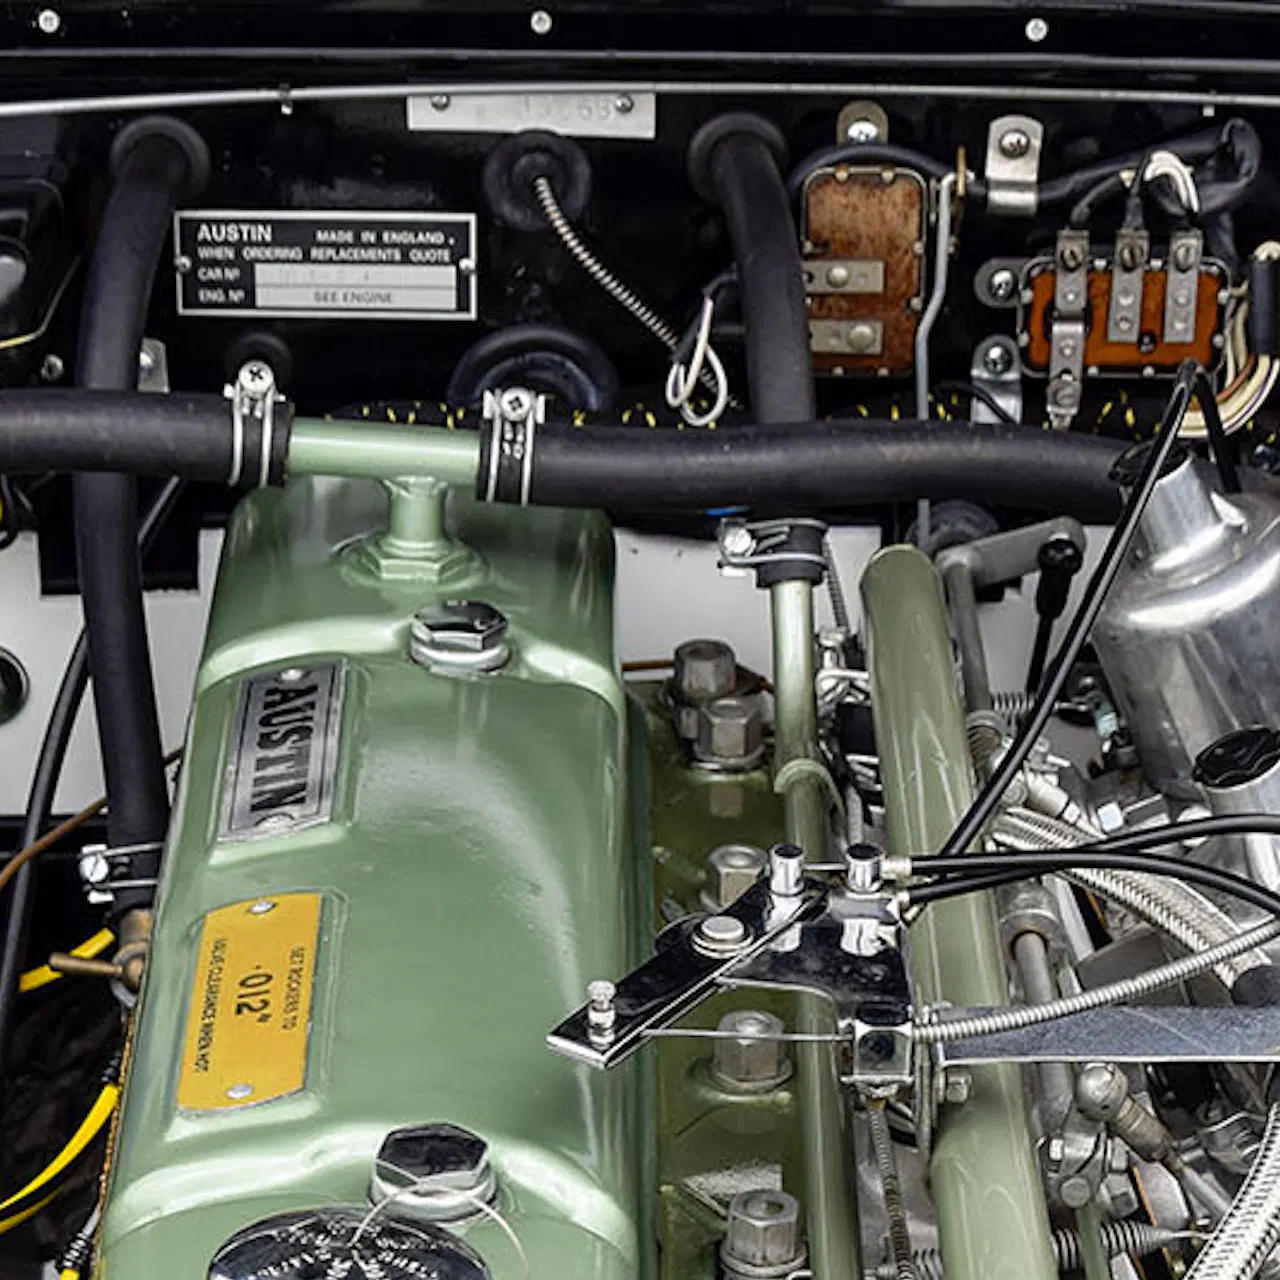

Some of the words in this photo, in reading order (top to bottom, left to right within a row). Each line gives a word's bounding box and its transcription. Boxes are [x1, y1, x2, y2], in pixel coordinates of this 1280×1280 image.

[197, 224, 272, 242] AUSTIN
[317, 230, 354, 244] MADE
[361, 231, 376, 244] IN
[382, 231, 445, 246] ENGLAND
[197, 247, 236, 261] WHEN
[242, 247, 303, 262] ORDERING
[310, 248, 402, 262] REPLACEMENTS
[409, 249, 451, 264] QUOTE
[249, 683, 319, 813] AUSTIN
